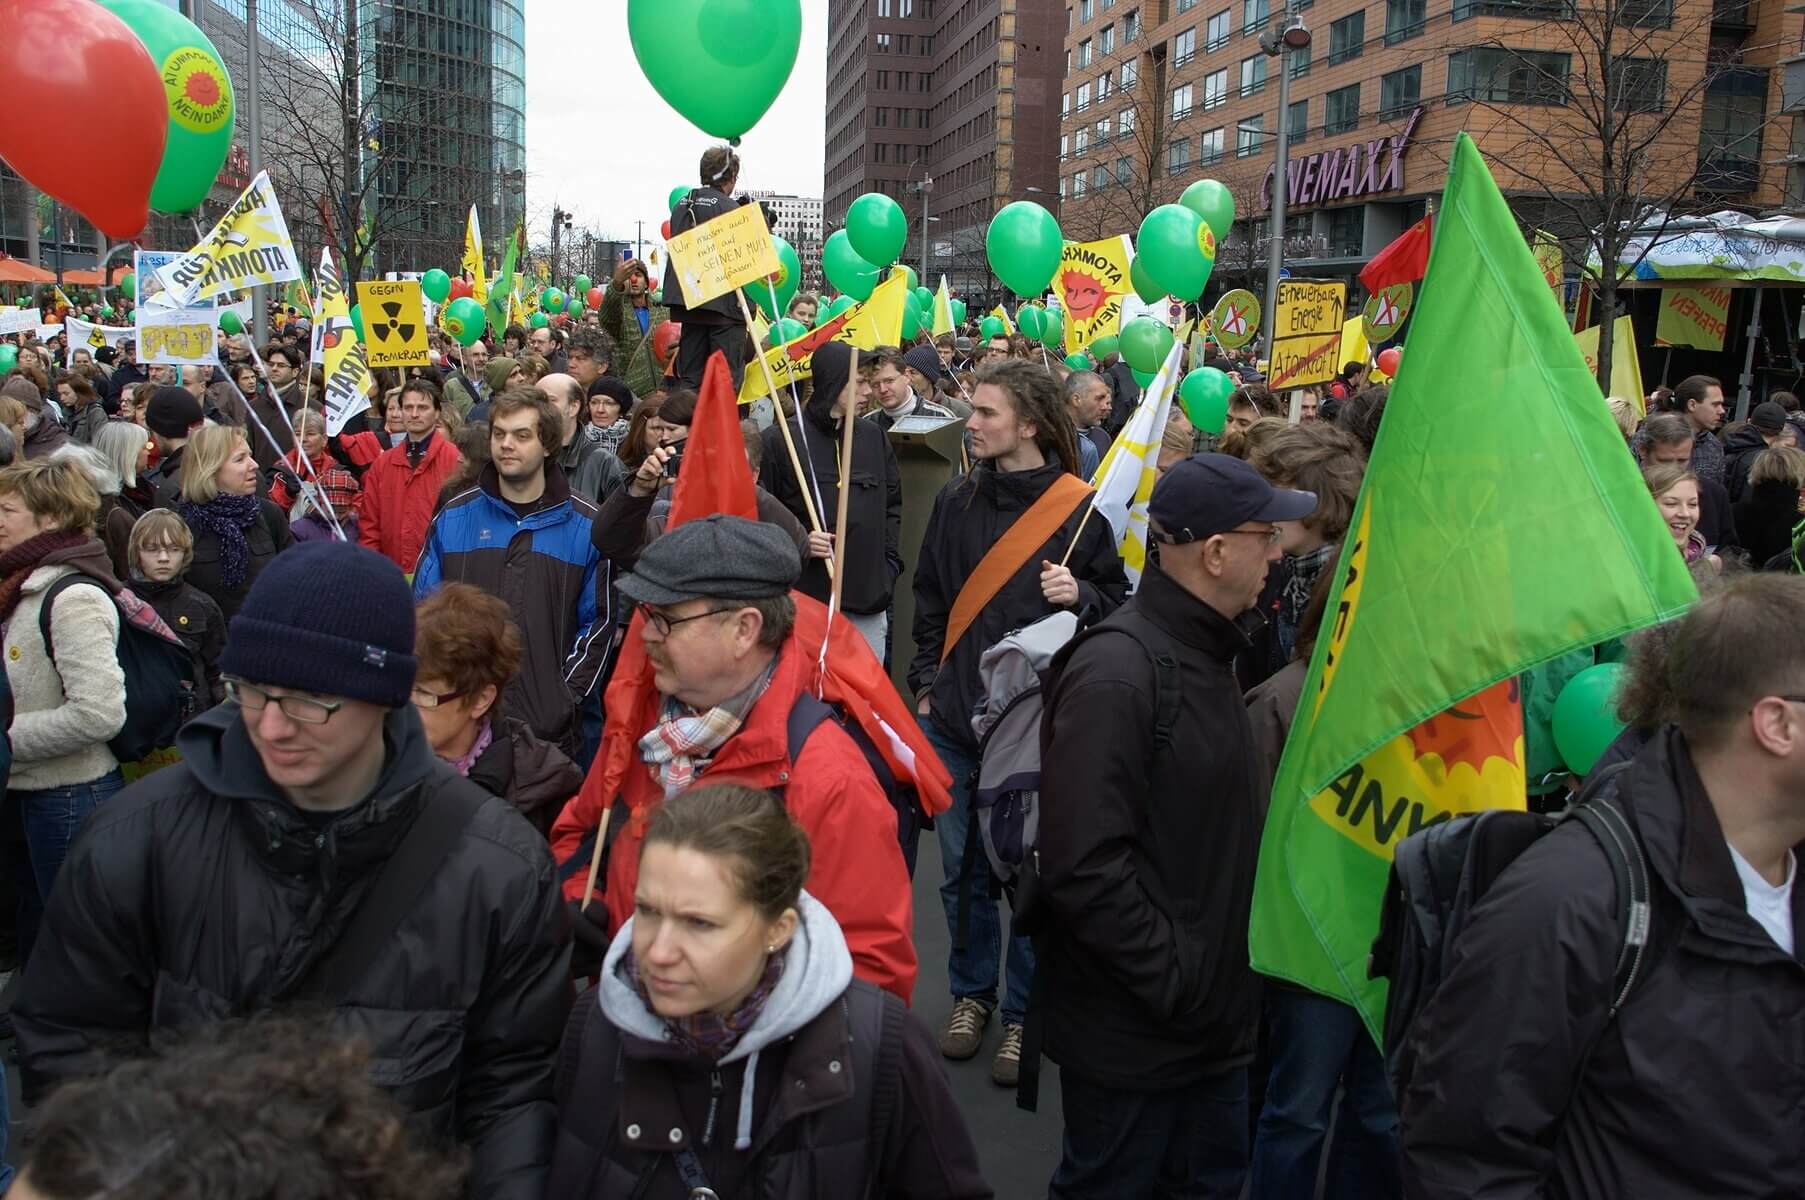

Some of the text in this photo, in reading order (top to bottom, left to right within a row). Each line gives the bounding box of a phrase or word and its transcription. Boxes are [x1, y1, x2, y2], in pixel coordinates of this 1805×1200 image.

[172, 98, 203, 123] NEIN
[1259, 105, 1425, 211] CNEMAXX
[703, 248, 742, 272] SEINEN
[1277, 285, 1336, 305] Erneuerbare
[1290, 305, 1323, 331] Energie
[371, 349, 429, 364] ATOMKRAFT
[1271, 343, 1336, 379] Atomkraft
